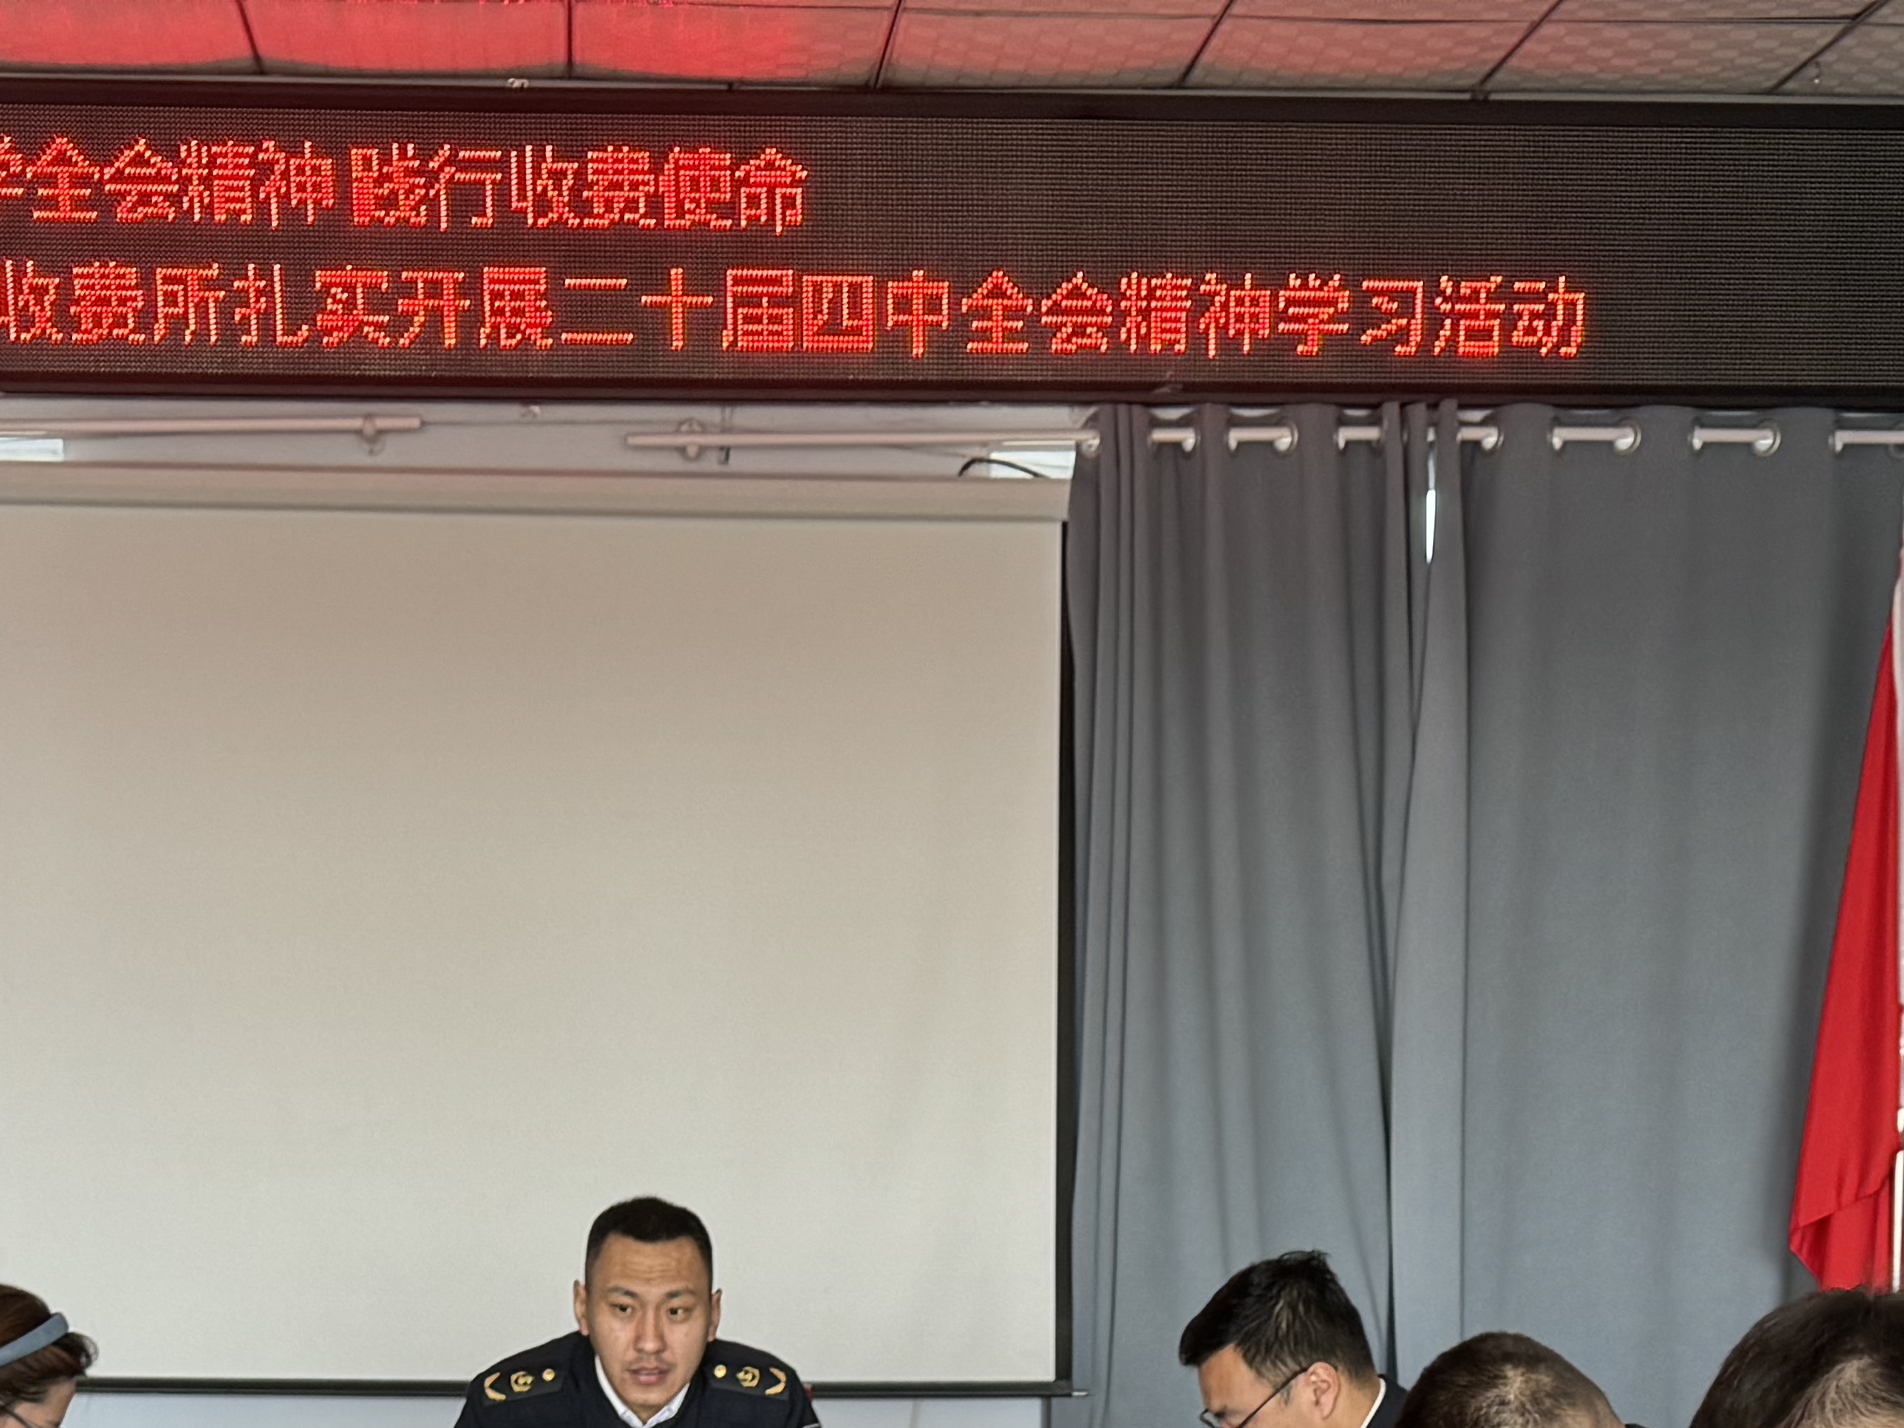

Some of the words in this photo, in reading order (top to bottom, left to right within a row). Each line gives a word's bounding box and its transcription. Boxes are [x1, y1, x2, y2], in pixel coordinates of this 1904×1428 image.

[349, 142, 810, 236] 践行收费使命
